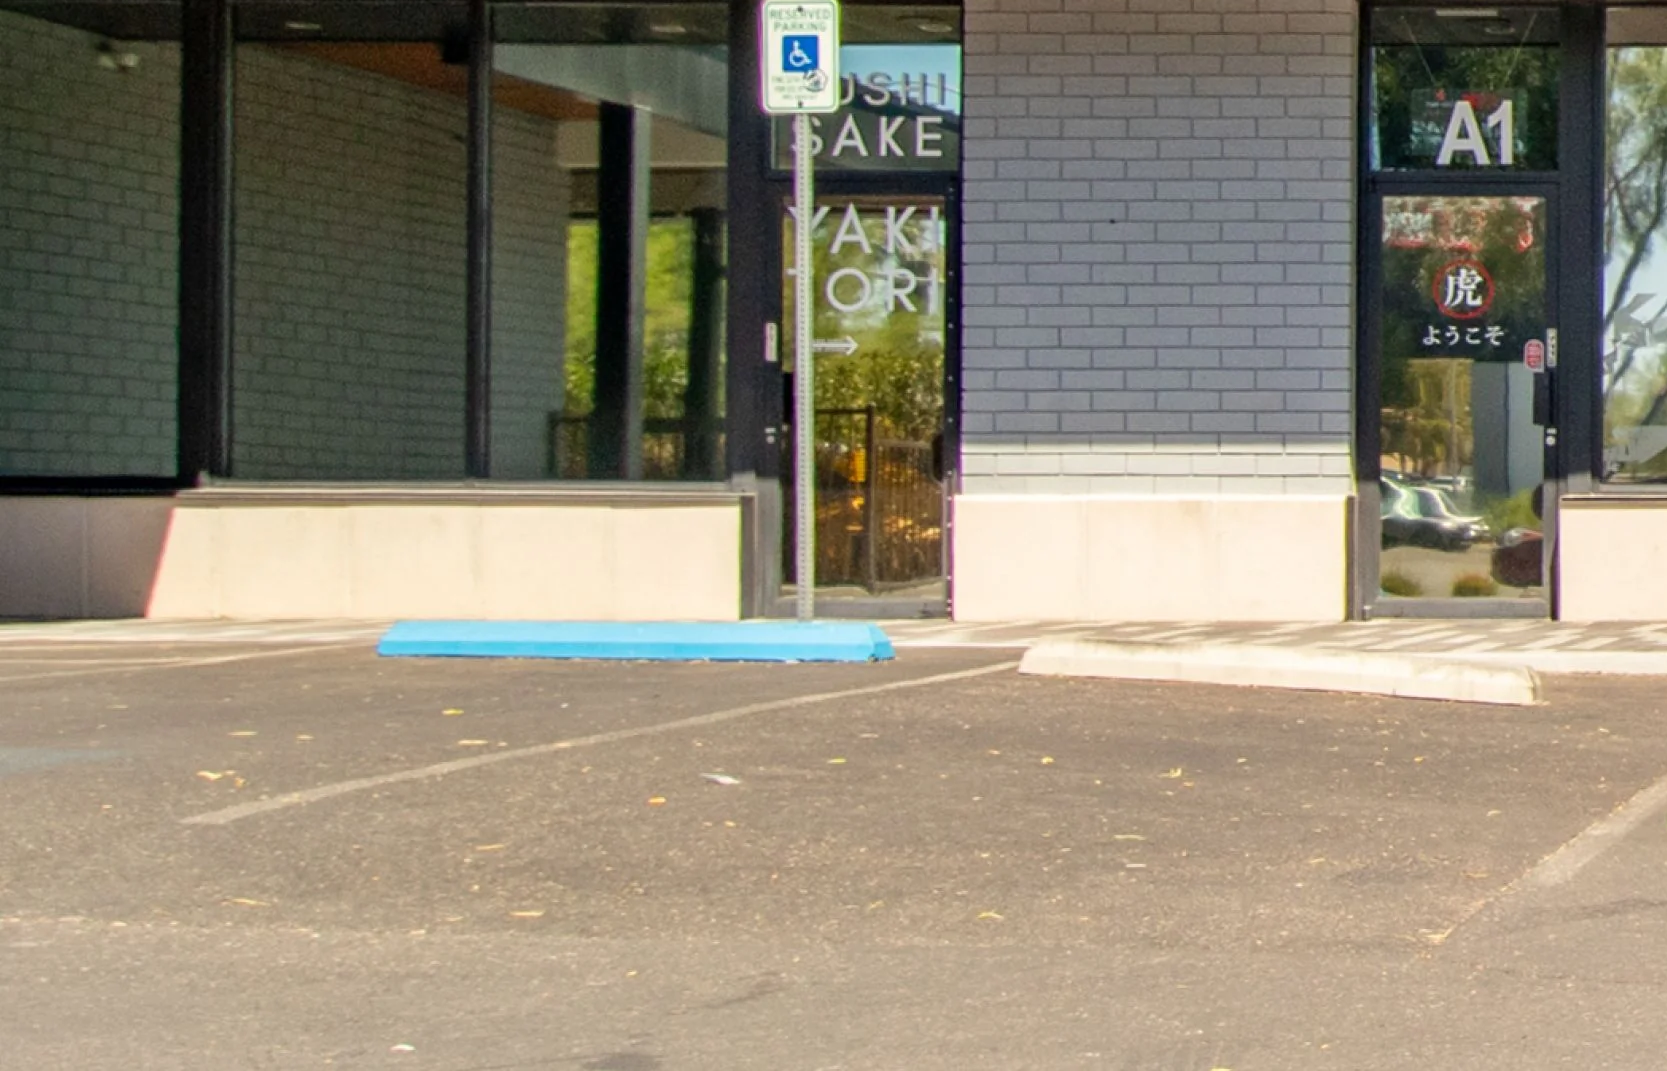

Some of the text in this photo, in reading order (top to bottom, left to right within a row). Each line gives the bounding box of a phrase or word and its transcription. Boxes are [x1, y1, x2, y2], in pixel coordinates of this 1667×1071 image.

[1436, 99, 1514, 166] A1
[1443, 267, 1484, 308] 虎
[1422, 325, 1505, 346] ようこそ
